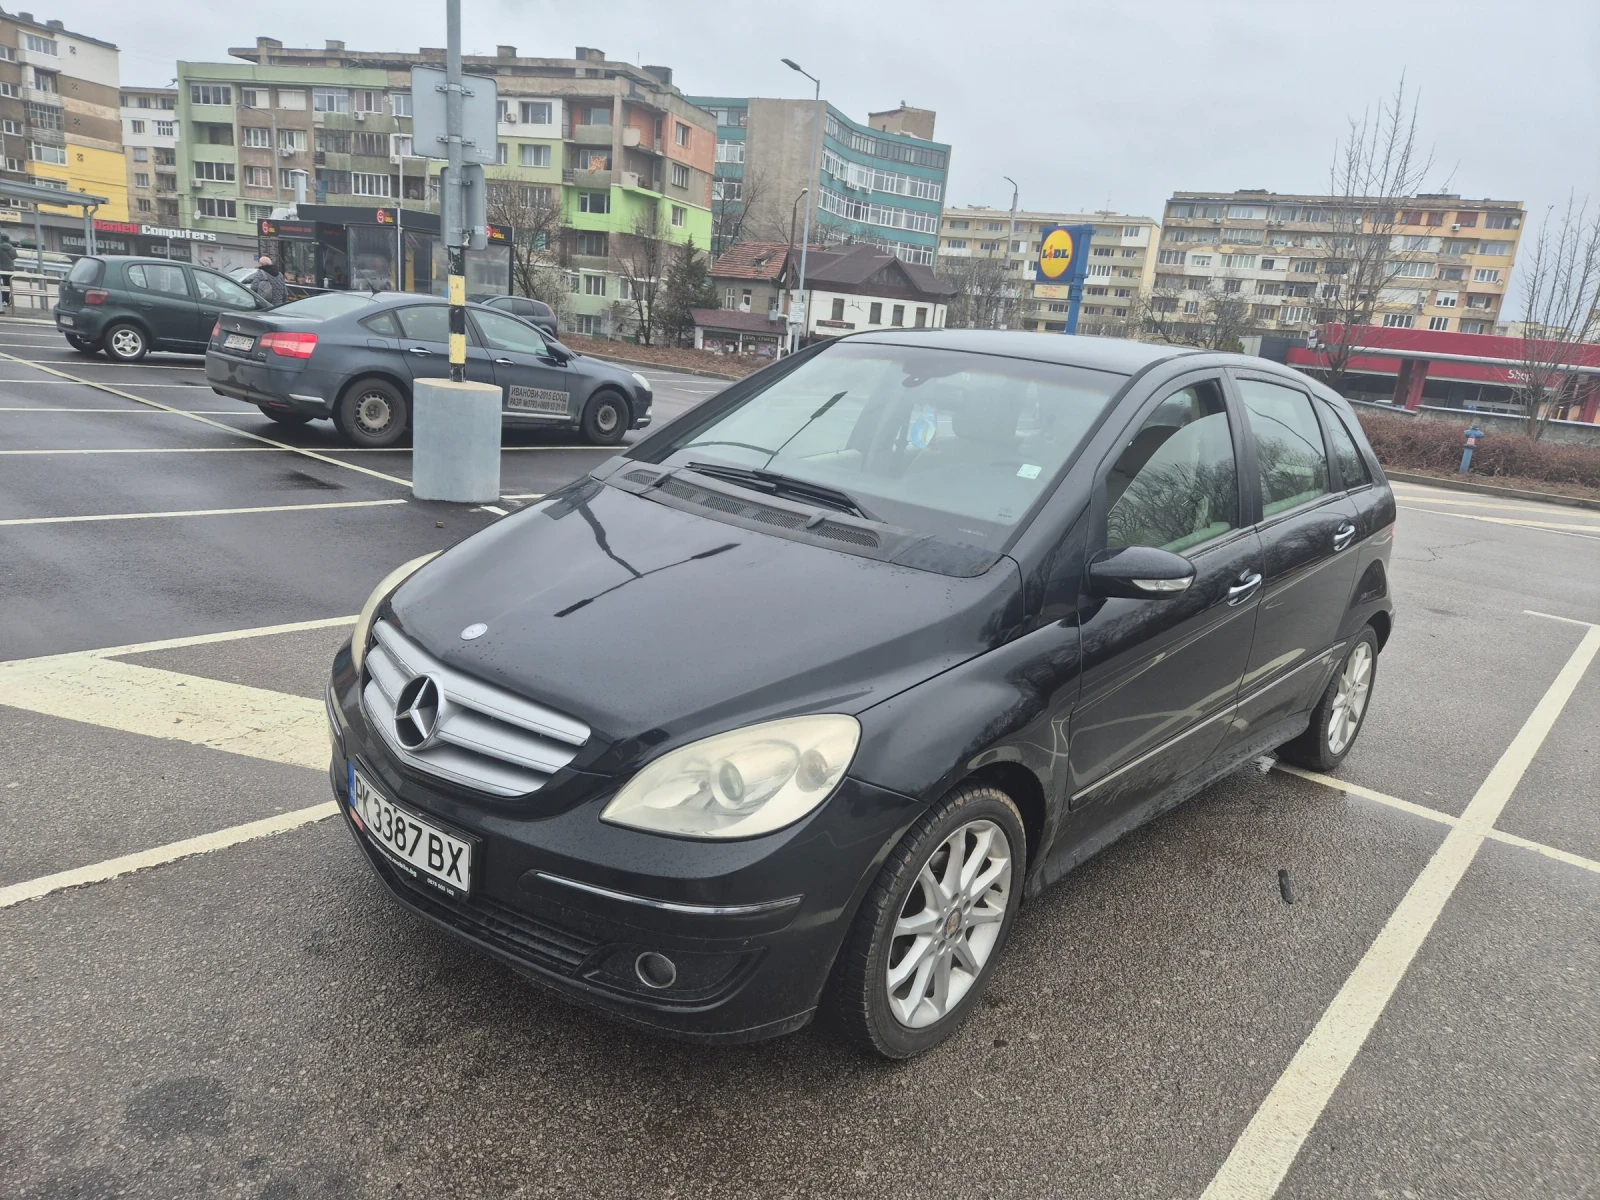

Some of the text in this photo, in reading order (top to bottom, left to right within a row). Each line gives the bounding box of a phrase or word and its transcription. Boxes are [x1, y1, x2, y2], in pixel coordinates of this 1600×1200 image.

[141, 224, 217, 242] Computers
[62, 236, 125, 251] КОМЮТРИ
[355, 775, 371, 824] PK
[373, 797, 423, 858] 3387
[428, 832, 464, 884] BX
